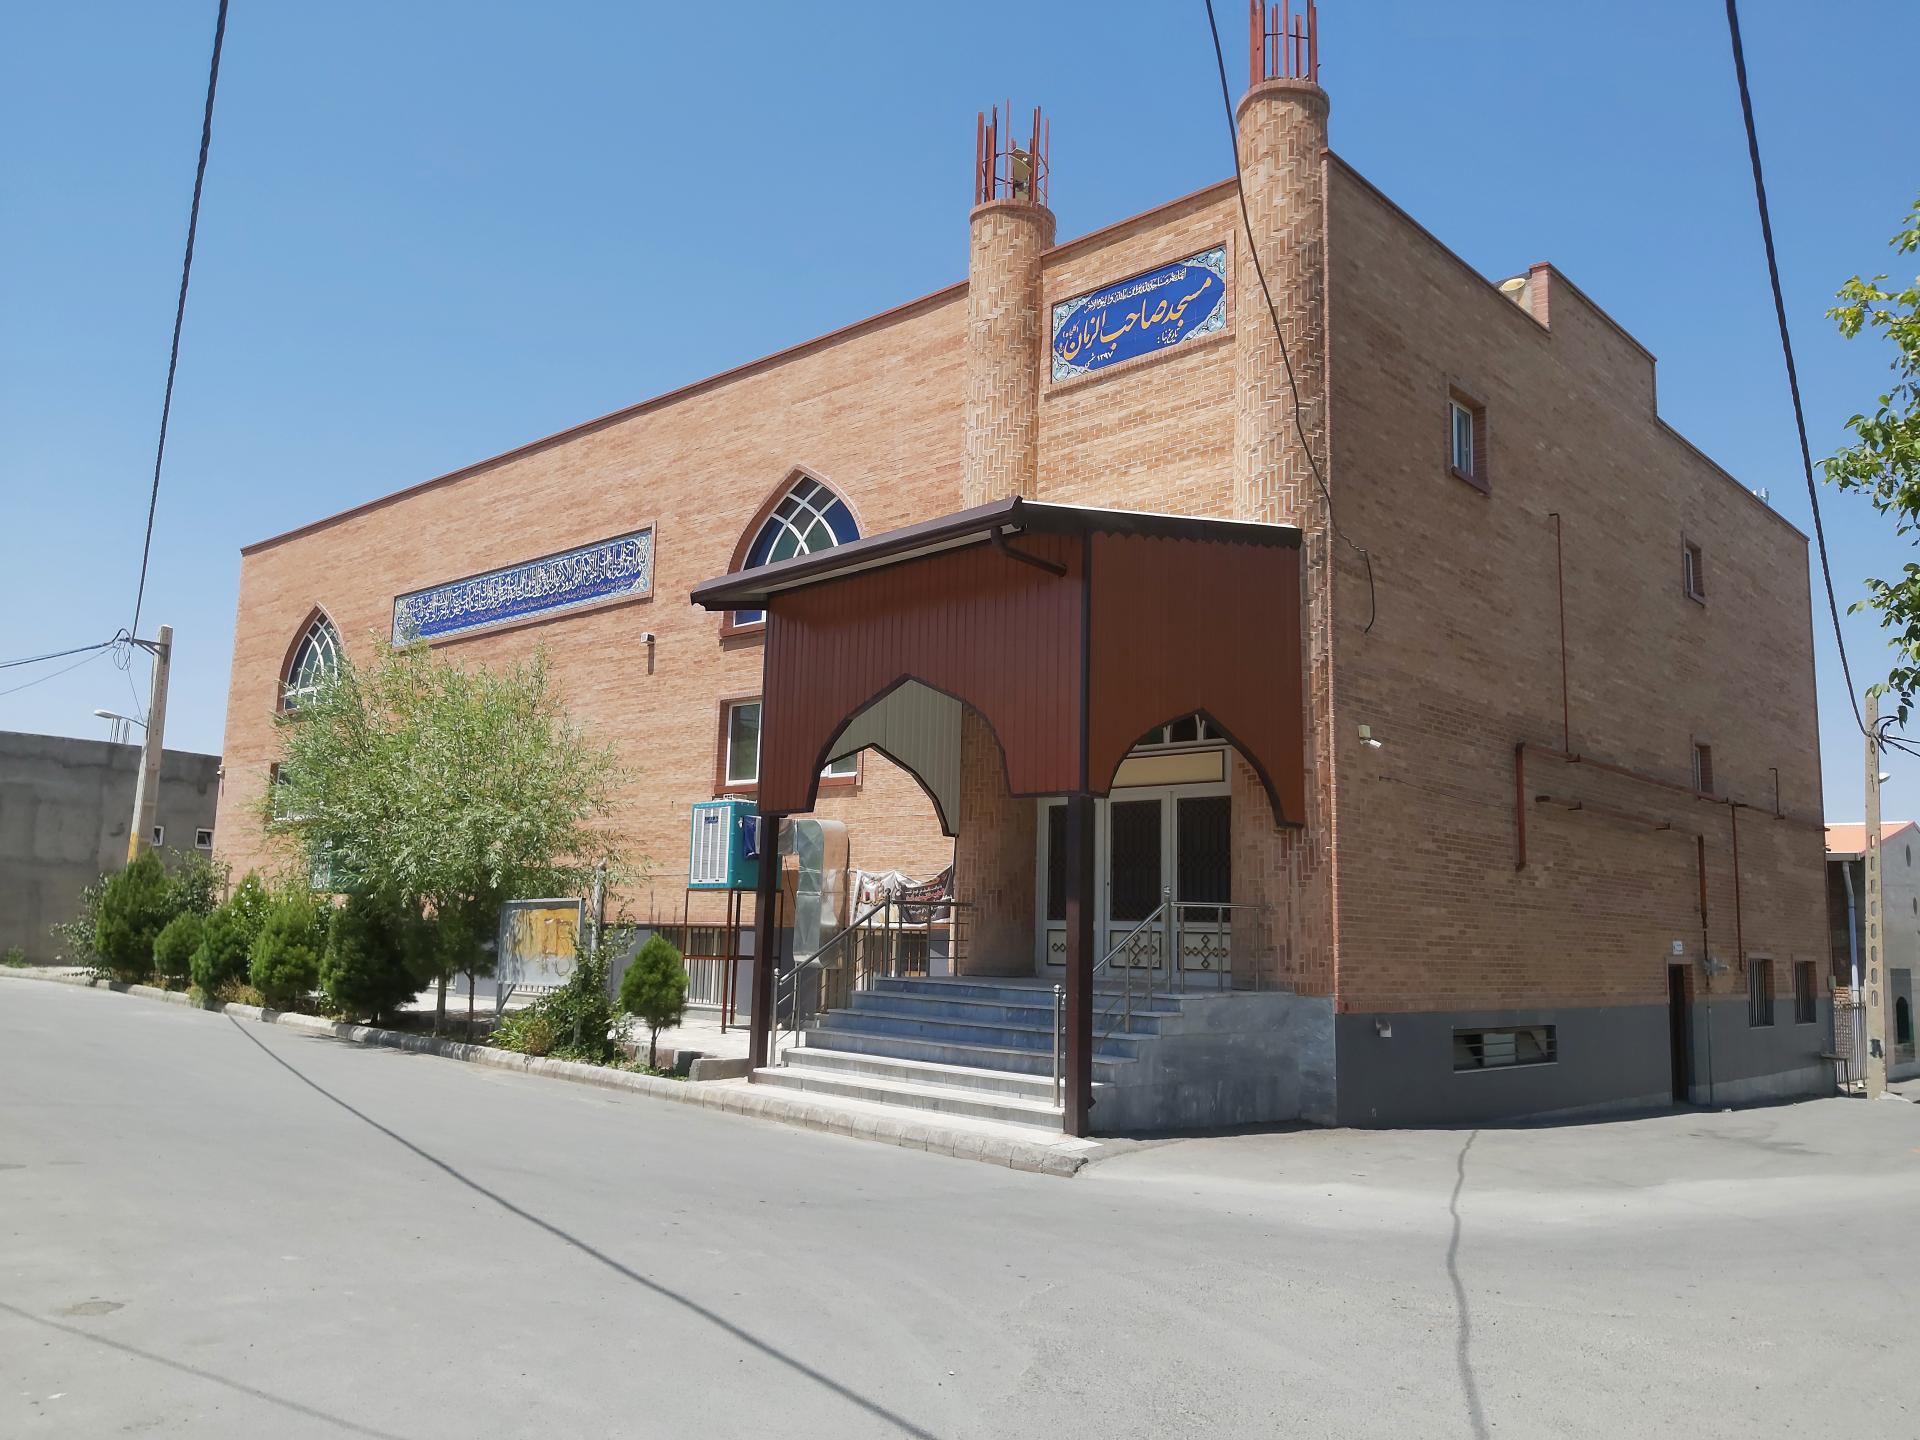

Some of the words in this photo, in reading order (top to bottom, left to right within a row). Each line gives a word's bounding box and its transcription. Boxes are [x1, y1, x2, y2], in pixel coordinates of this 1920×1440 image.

[1100, 299, 1167, 350] صاحب
[1162, 277, 1212, 328] مسجد
[1063, 309, 1106, 361] الزمان
